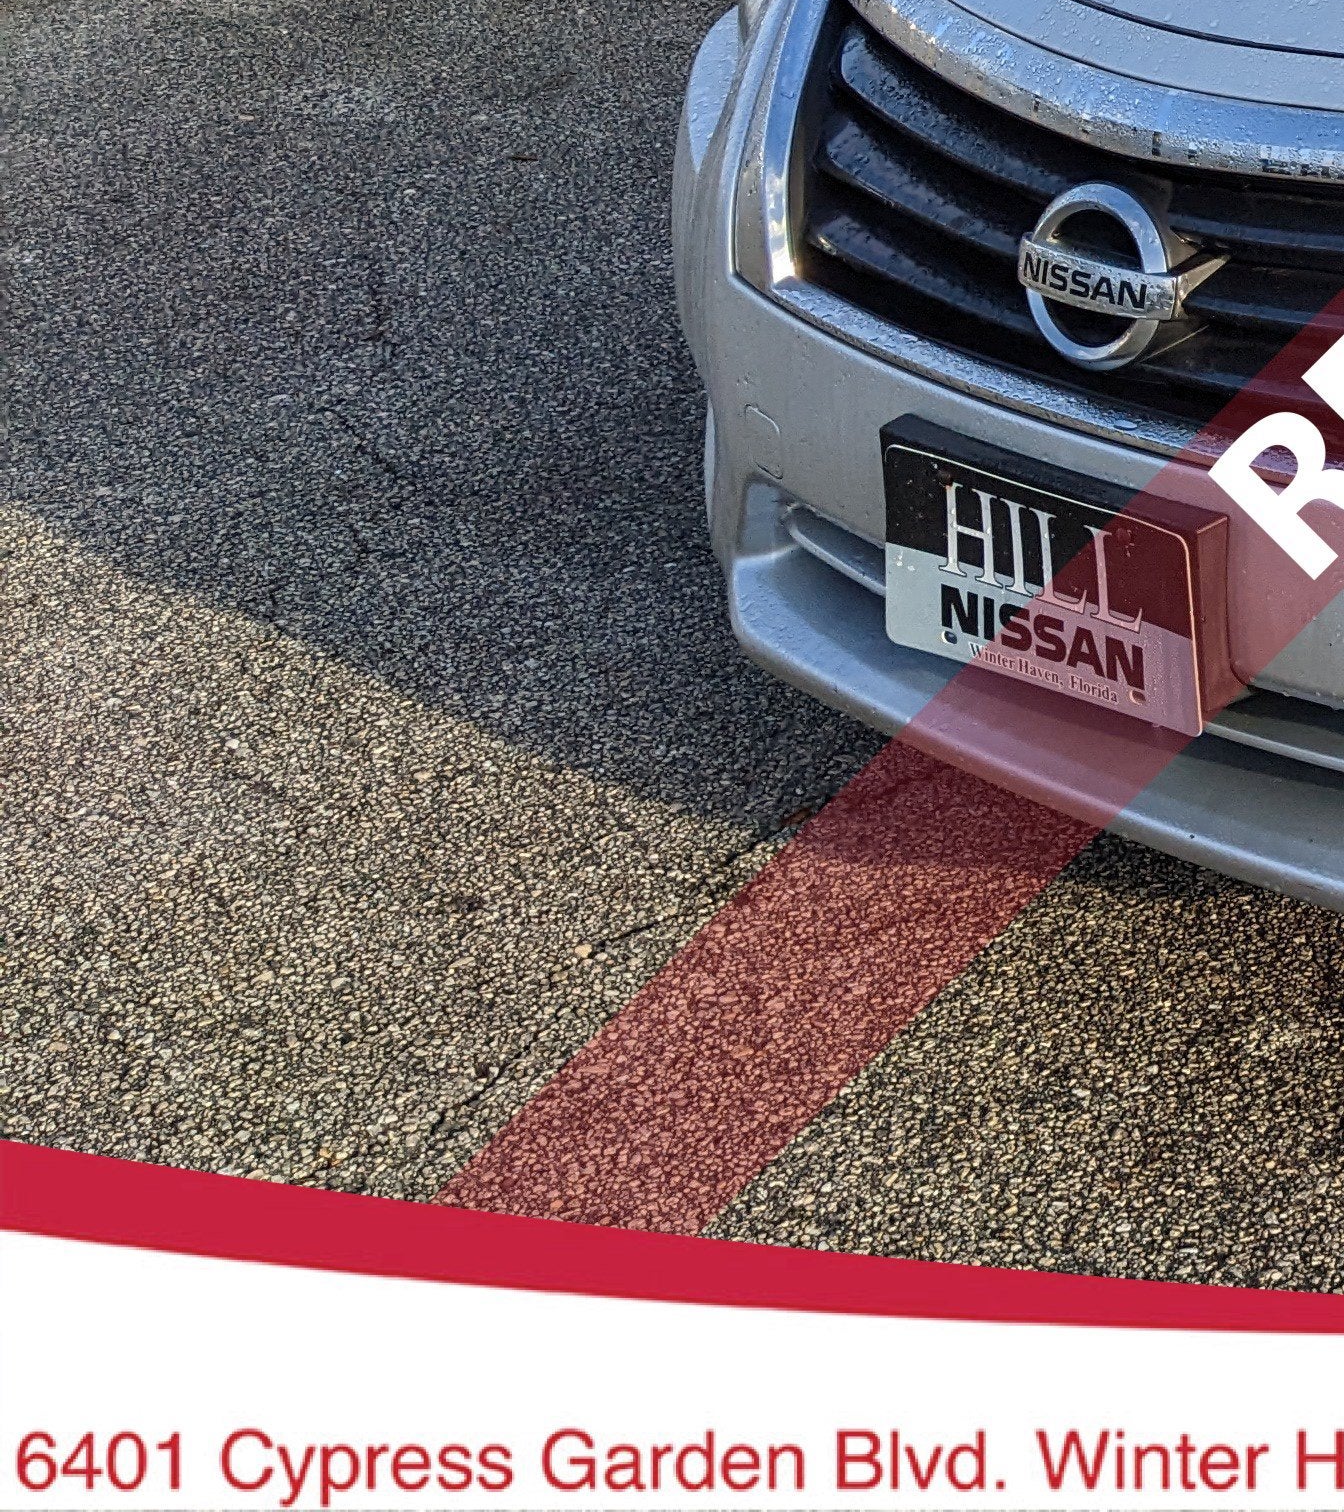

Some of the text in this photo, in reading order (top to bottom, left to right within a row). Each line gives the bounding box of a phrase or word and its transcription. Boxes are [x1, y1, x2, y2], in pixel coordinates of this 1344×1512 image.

[1023, 251, 1147, 309] NISSAN
[938, 482, 1143, 634] HILL
[941, 583, 1146, 691] NISSAN
[969, 643, 1119, 704] Winter Haven, Florida
